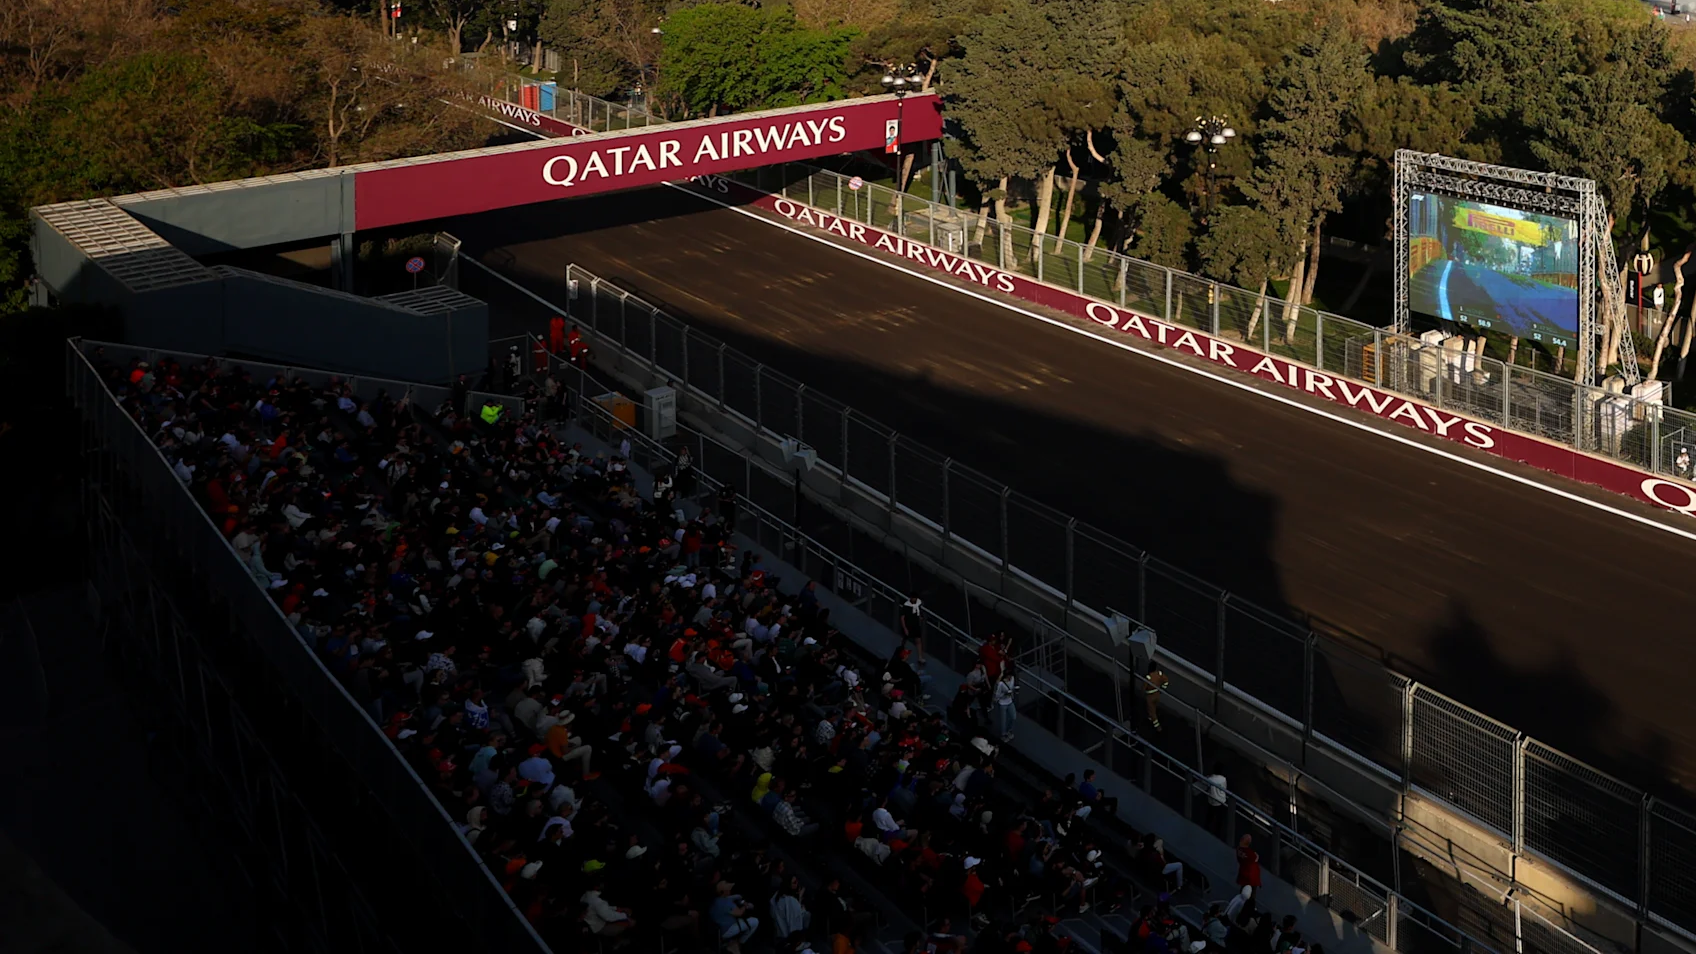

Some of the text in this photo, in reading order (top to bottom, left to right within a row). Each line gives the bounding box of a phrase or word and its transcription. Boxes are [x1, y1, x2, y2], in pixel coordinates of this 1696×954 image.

[542, 140, 683, 187] QATAR
[693, 116, 846, 163] AIRWAYS
[774, 199, 1015, 293] QATAR AIRWAYS
[1085, 302, 1495, 449] QATAR AIRWAYS
